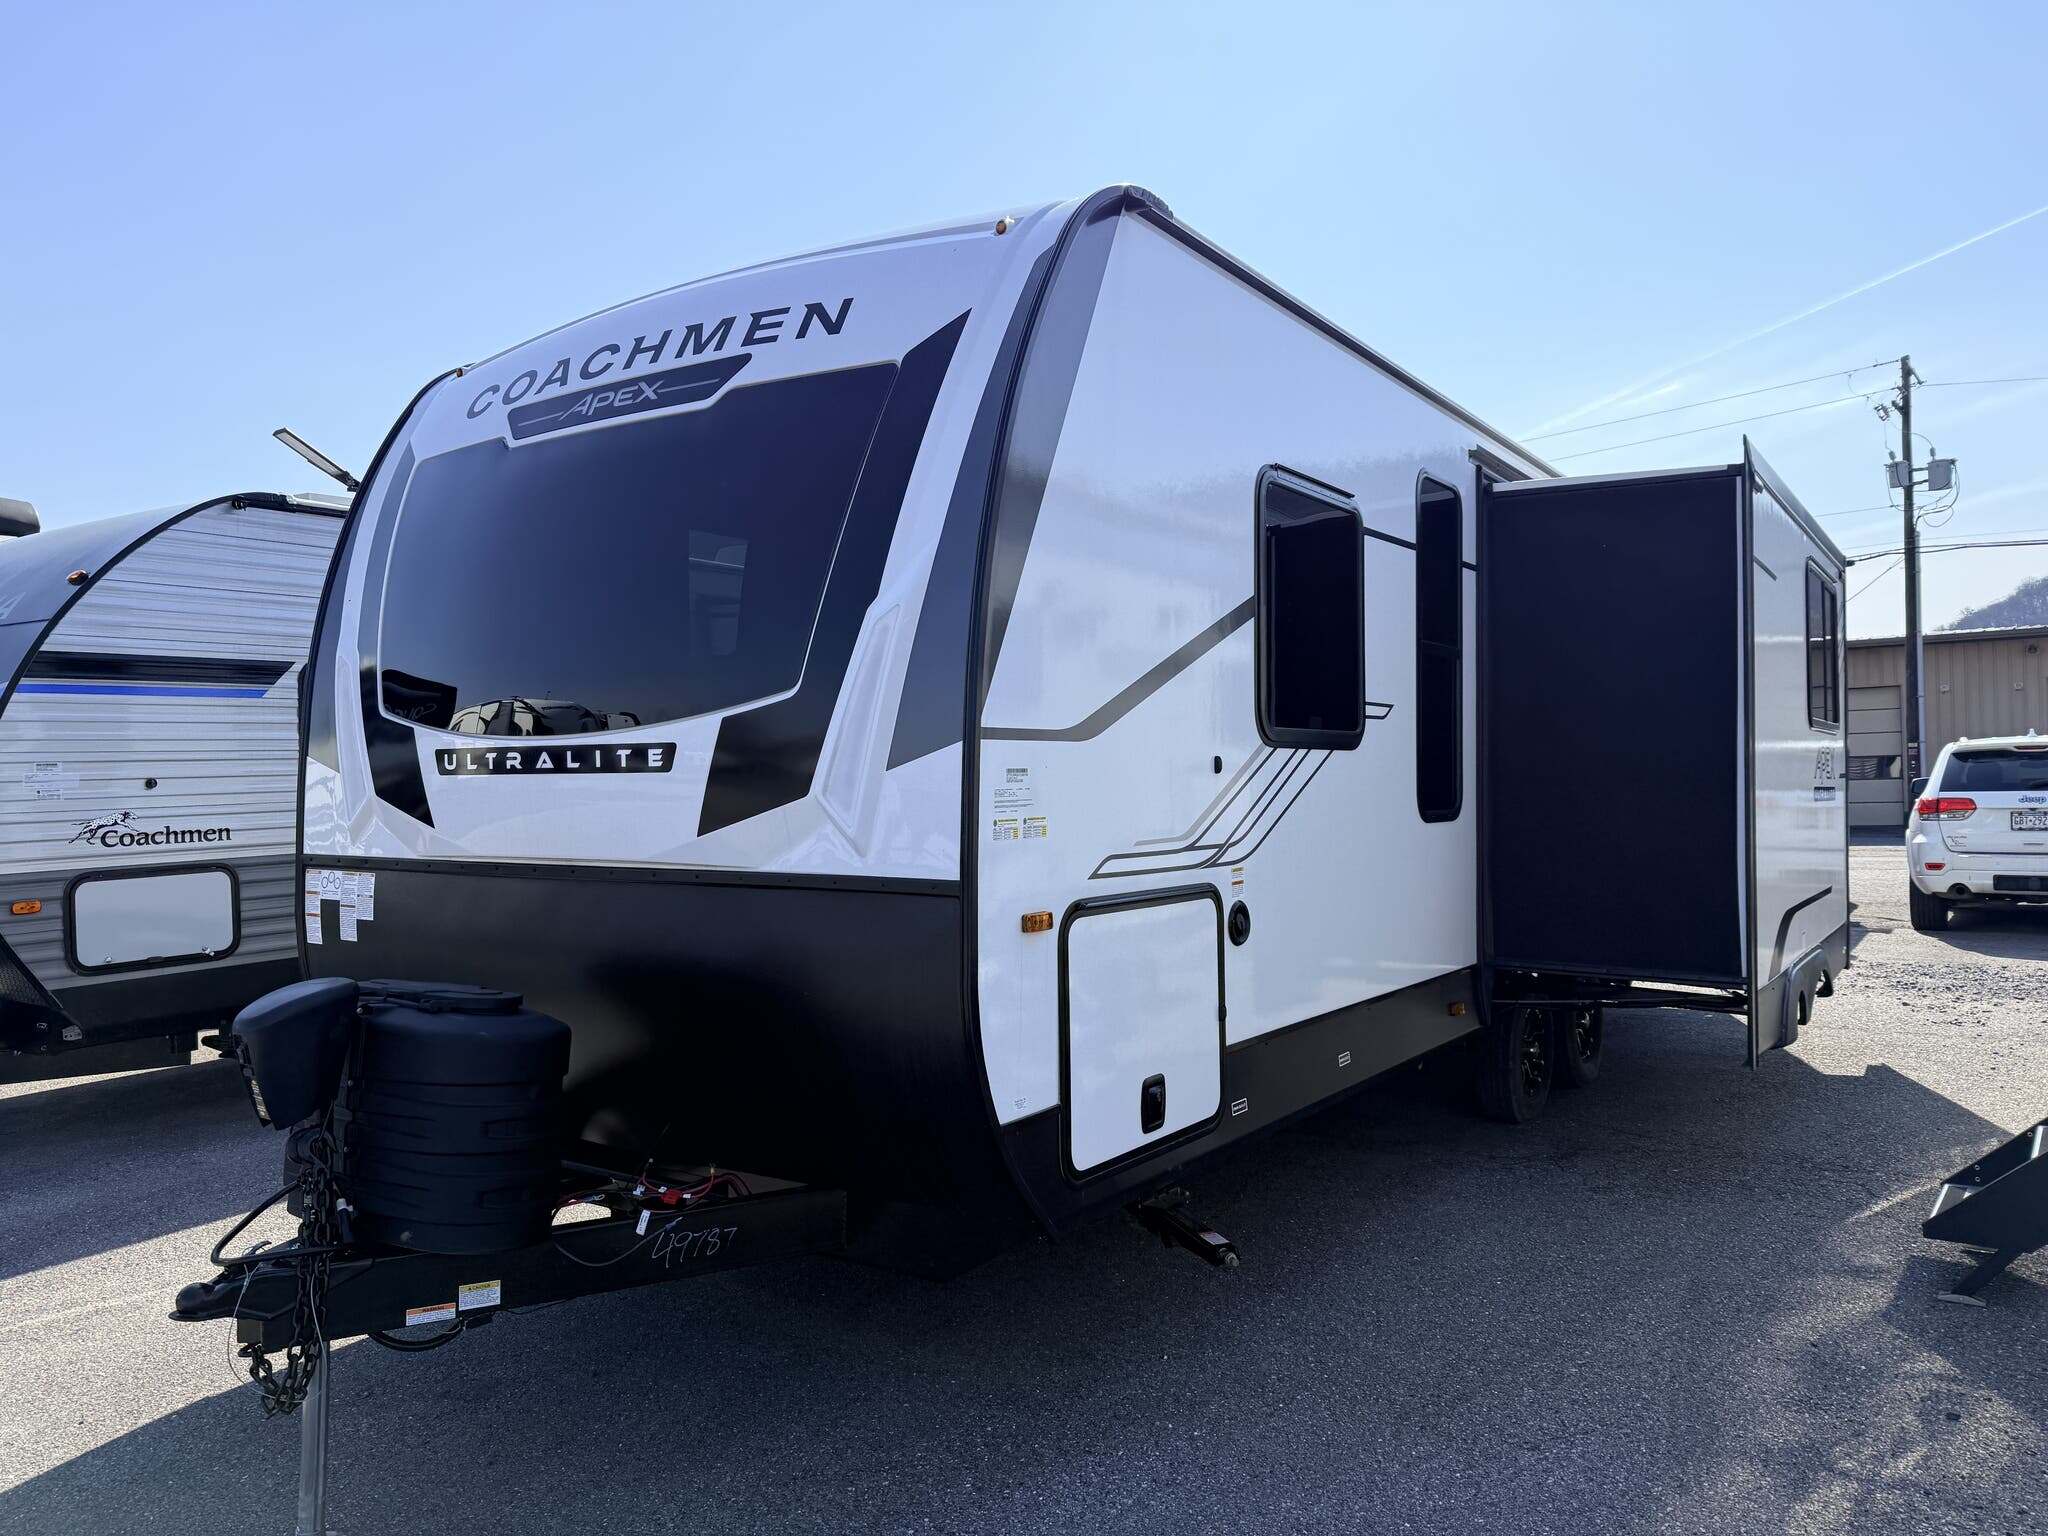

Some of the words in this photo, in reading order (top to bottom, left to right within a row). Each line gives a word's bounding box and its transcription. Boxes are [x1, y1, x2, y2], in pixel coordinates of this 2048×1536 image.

[467, 297, 854, 420] COACHMEN
[559, 379, 663, 421] APEX
[444, 748, 665, 771] ULTRALITE
[100, 826, 232, 848] Coachmen
[652, 1226, 738, 1269] 49787
